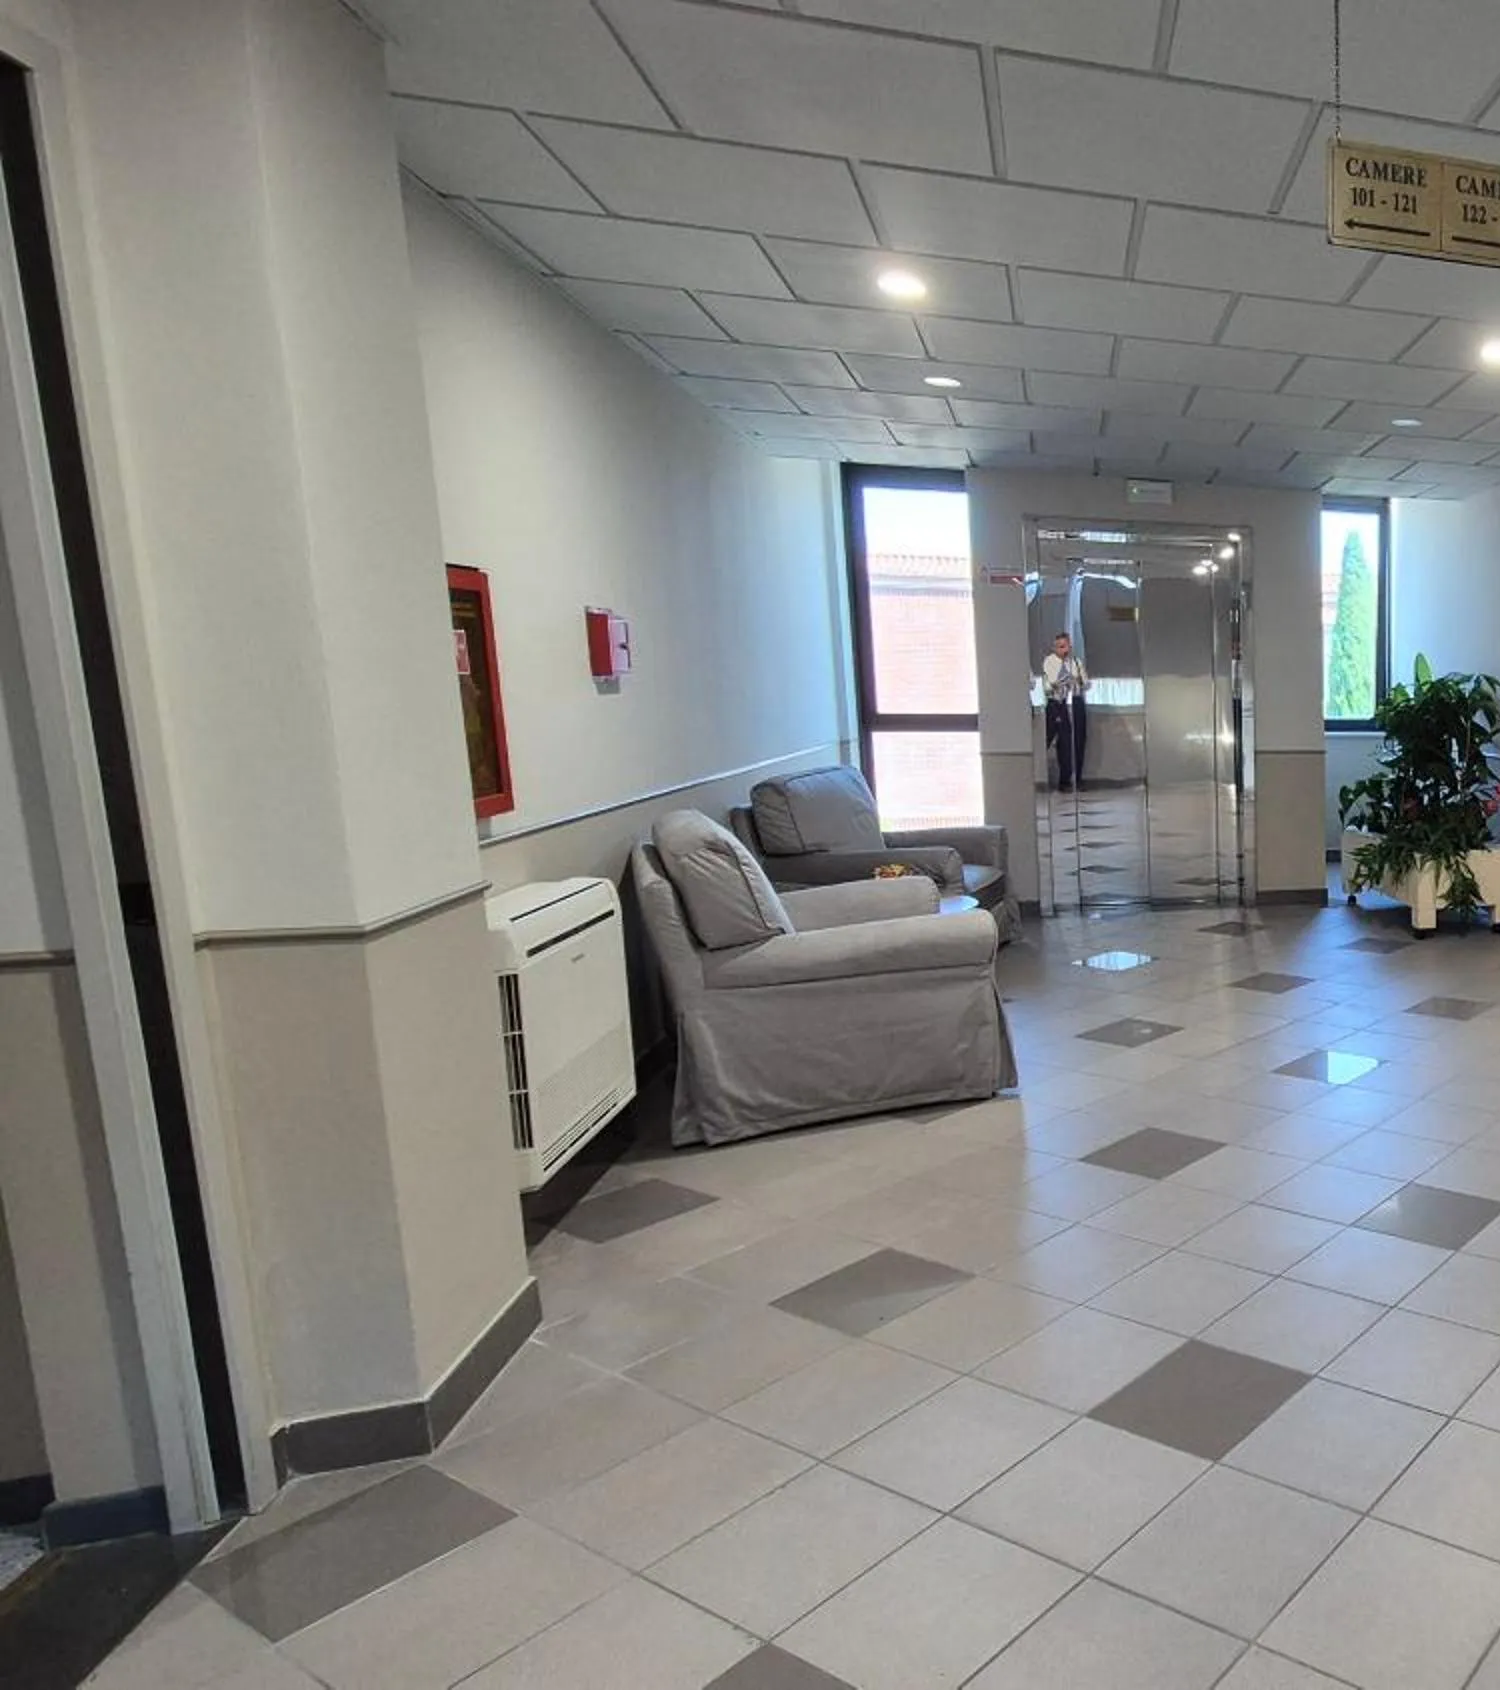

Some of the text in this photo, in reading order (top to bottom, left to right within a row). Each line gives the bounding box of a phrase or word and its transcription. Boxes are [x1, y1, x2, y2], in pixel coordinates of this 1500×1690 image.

[1345, 158, 1427, 187] CAMERE
[1351, 187, 1375, 208] 101
[1394, 193, 1417, 214] 121
[1462, 204, 1487, 225] 122
